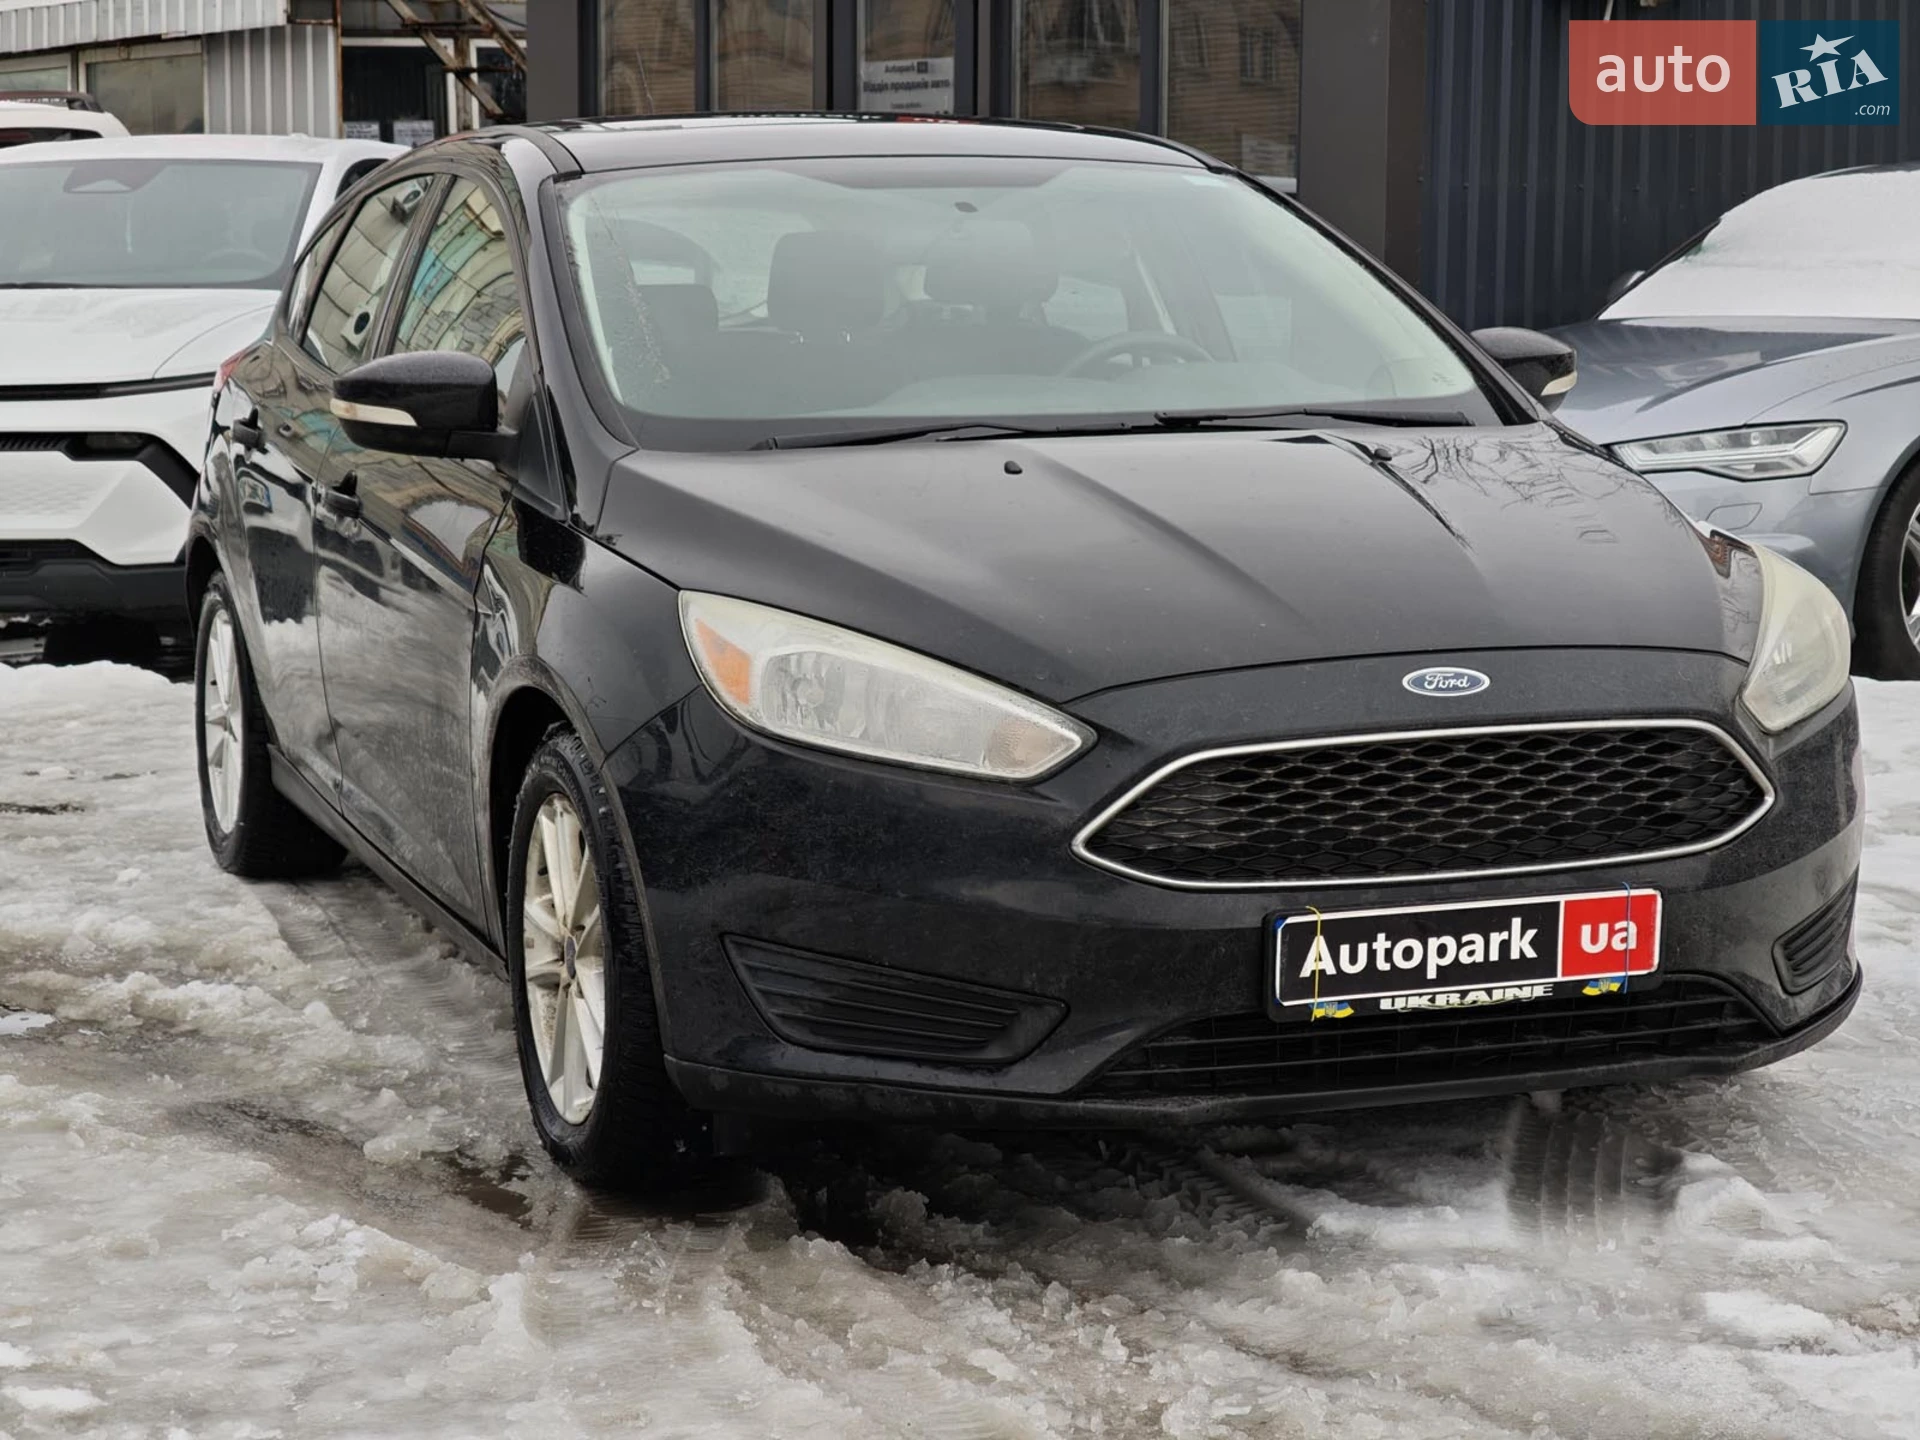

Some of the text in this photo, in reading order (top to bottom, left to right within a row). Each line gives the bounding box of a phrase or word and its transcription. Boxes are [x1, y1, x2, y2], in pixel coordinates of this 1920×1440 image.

[1424, 672, 1471, 690] Ford
[1299, 916, 1638, 980] Autopark ua
[1379, 984, 1555, 1011] UKRAINE
